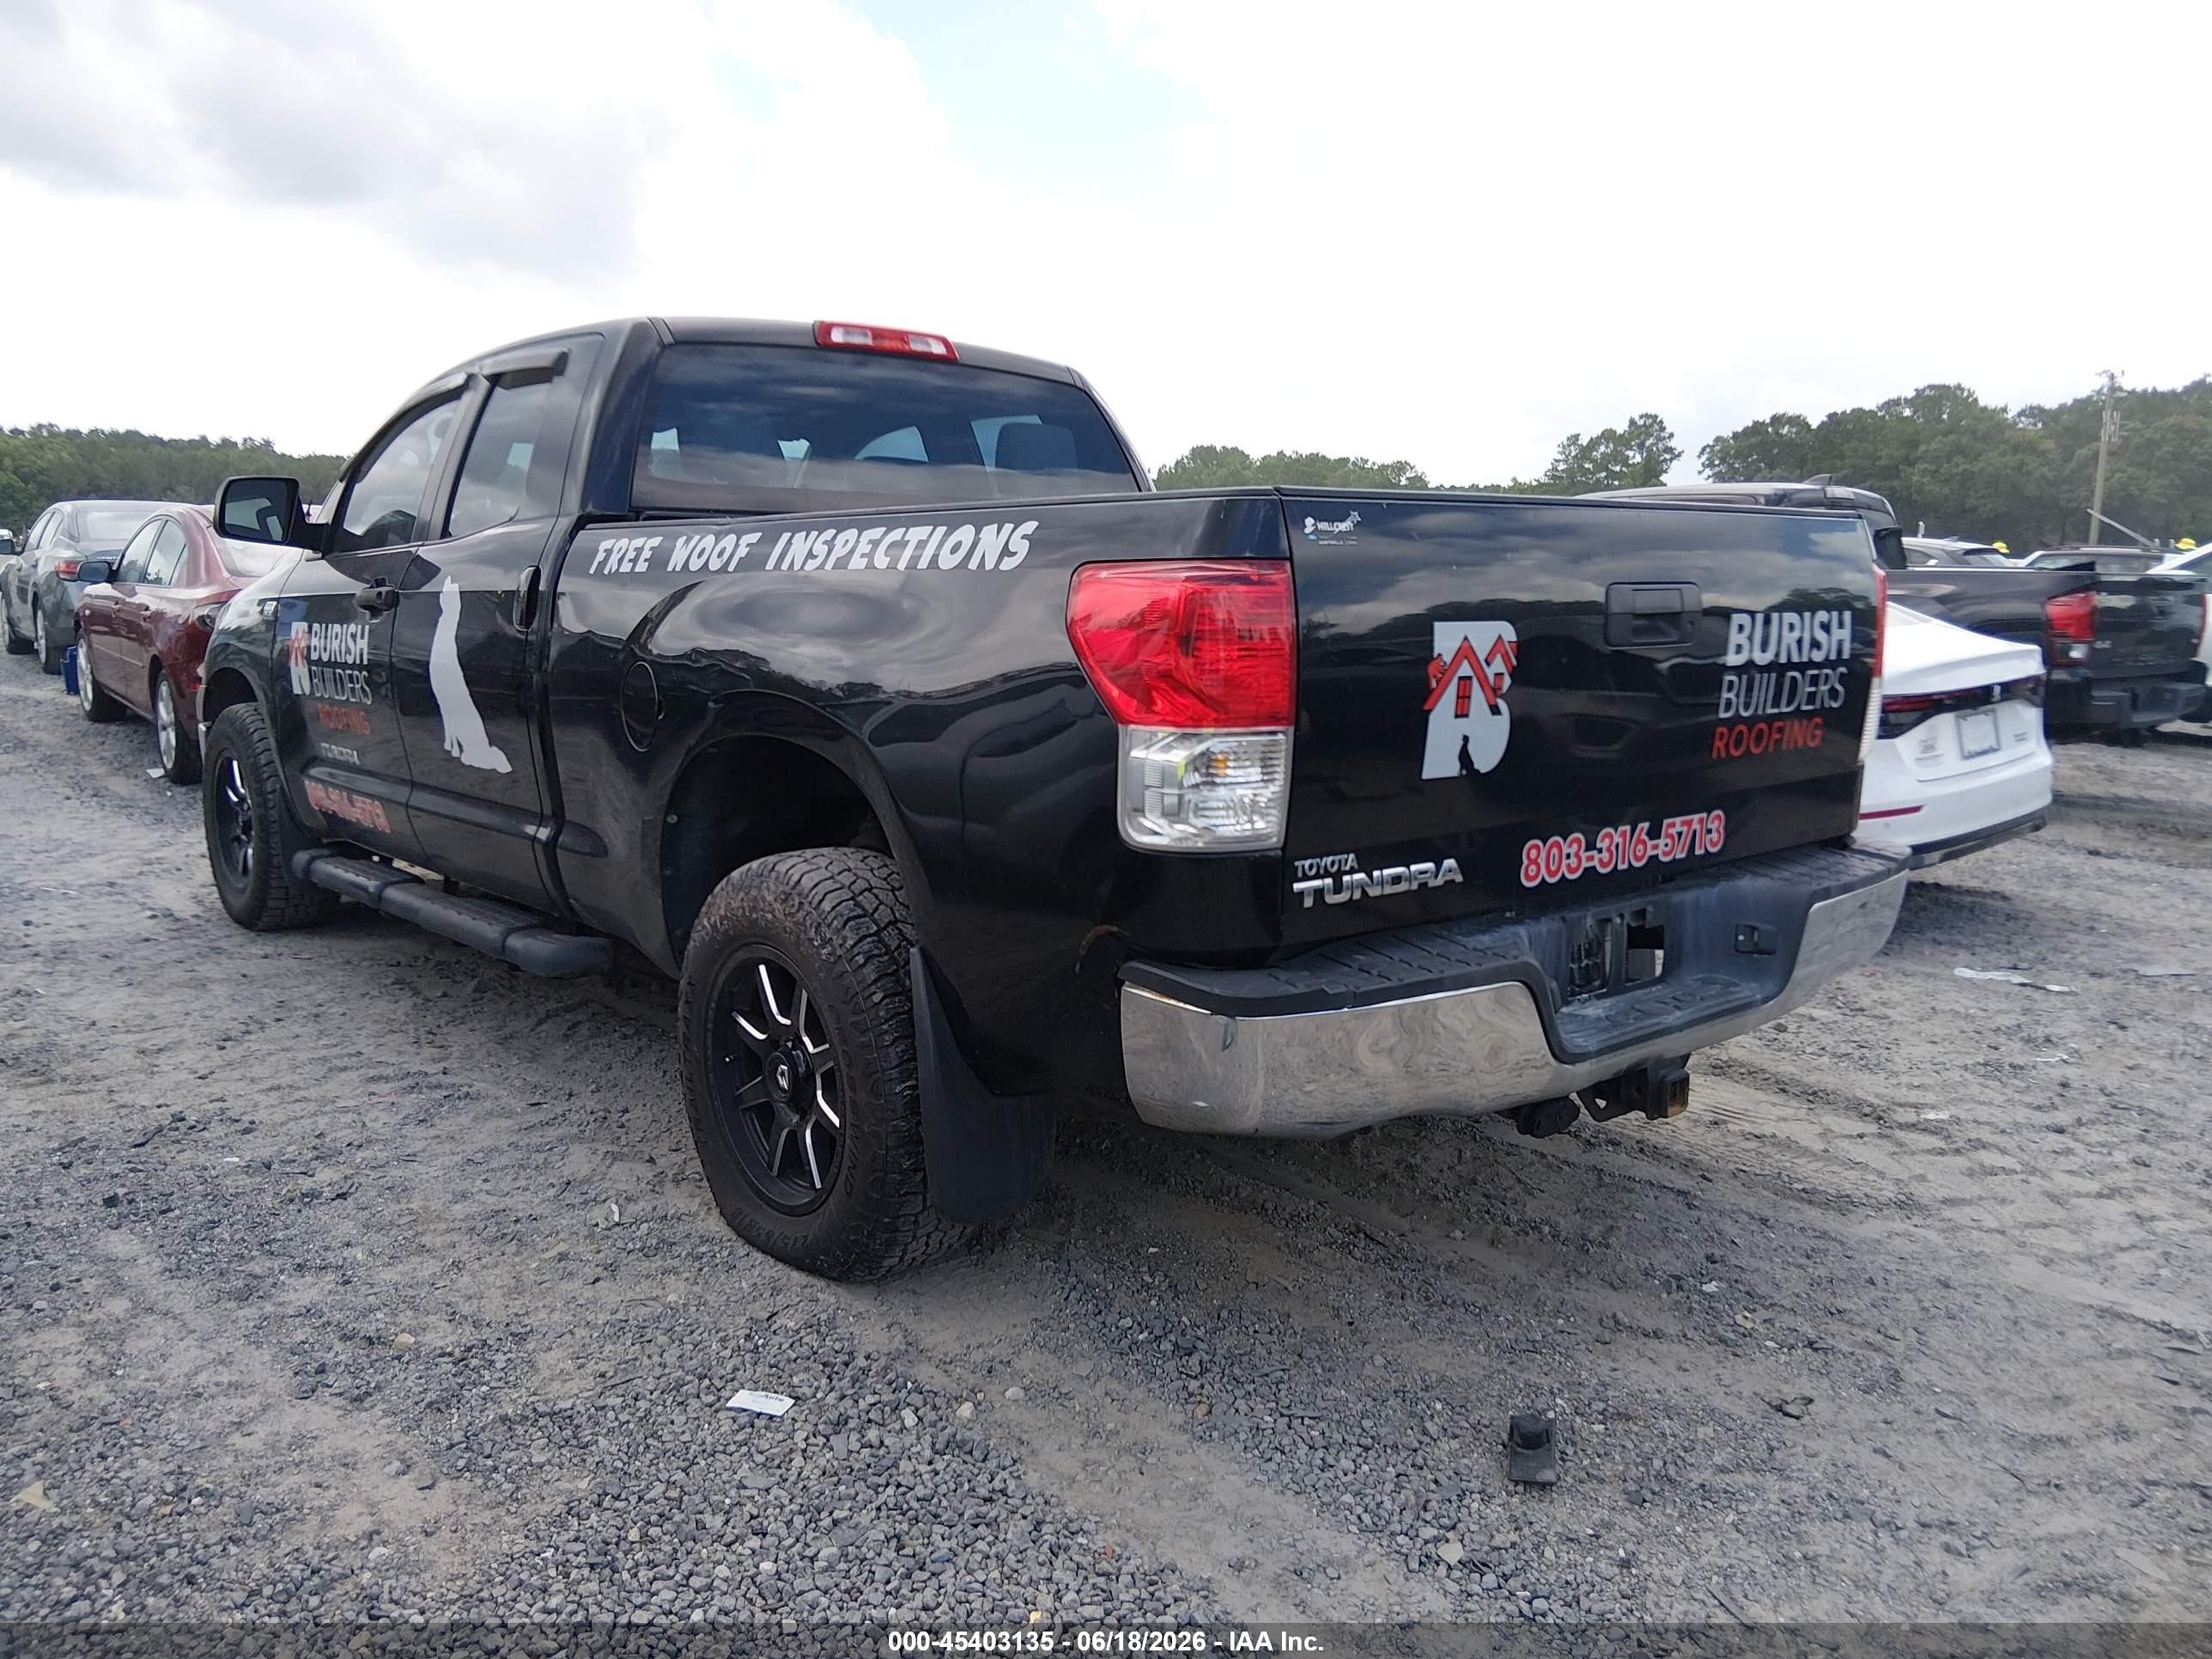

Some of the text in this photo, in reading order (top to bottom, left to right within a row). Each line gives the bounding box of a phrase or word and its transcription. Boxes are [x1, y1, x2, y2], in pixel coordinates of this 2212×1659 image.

[589, 520, 1039, 574] FREE WOOF INSPECTIONS
[310, 623, 370, 665] BURISH
[1726, 611, 1852, 666] BURISH
[311, 666, 372, 704] BUILDERS
[1718, 667, 1848, 719] BUILDERS
[1711, 717, 1824, 759] ROOFING
[1294, 853, 1358, 878] TOYOTA
[1520, 810, 1725, 888] 803-316-5713
[1292, 858, 1464, 908] TUNDRA
